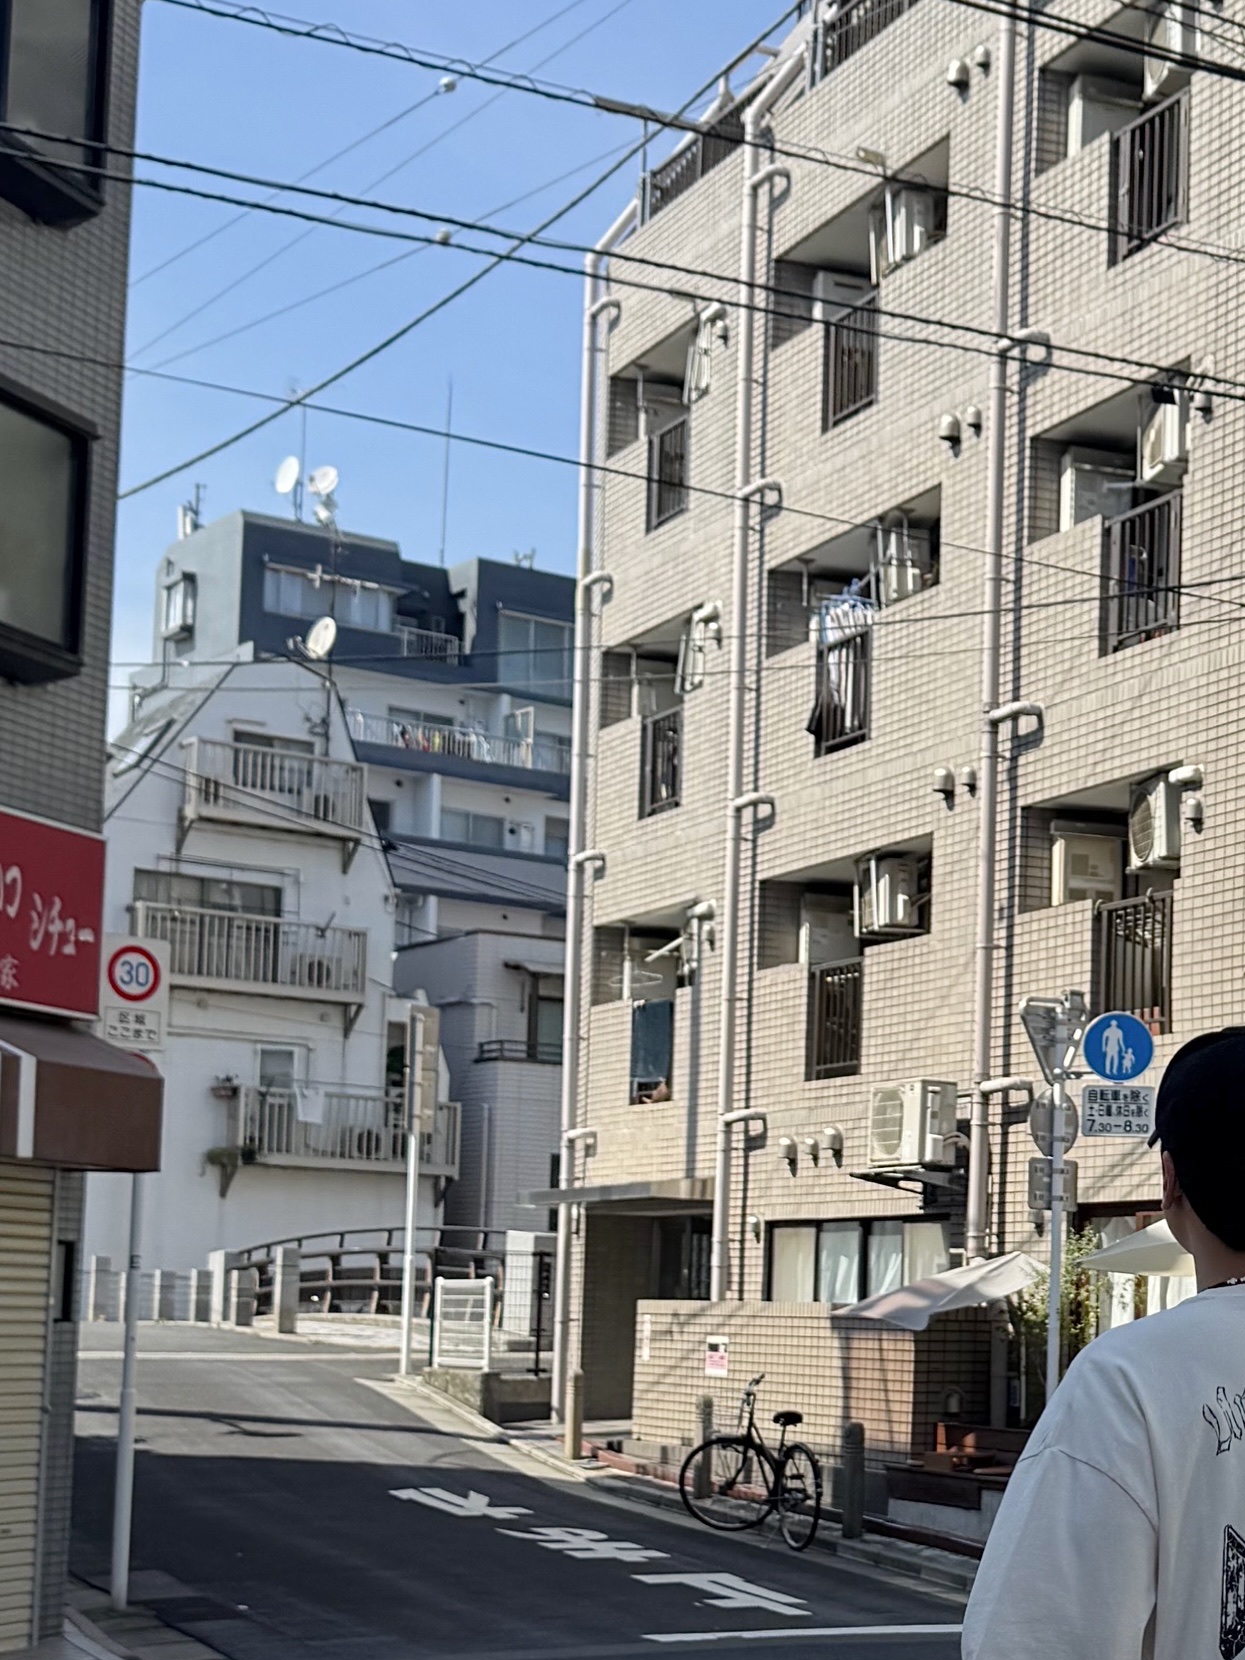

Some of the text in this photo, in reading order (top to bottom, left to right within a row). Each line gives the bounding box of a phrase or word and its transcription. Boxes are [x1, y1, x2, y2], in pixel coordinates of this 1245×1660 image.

[29, 891, 95, 957] シチュー
[119, 959, 151, 988] 30
[119, 1011, 146, 1026] 区域
[107, 1024, 158, 1041] ここまで
[1088, 1089, 1149, 1102] 自転車を除く
[388, 1486, 813, 1617] 止まれ
